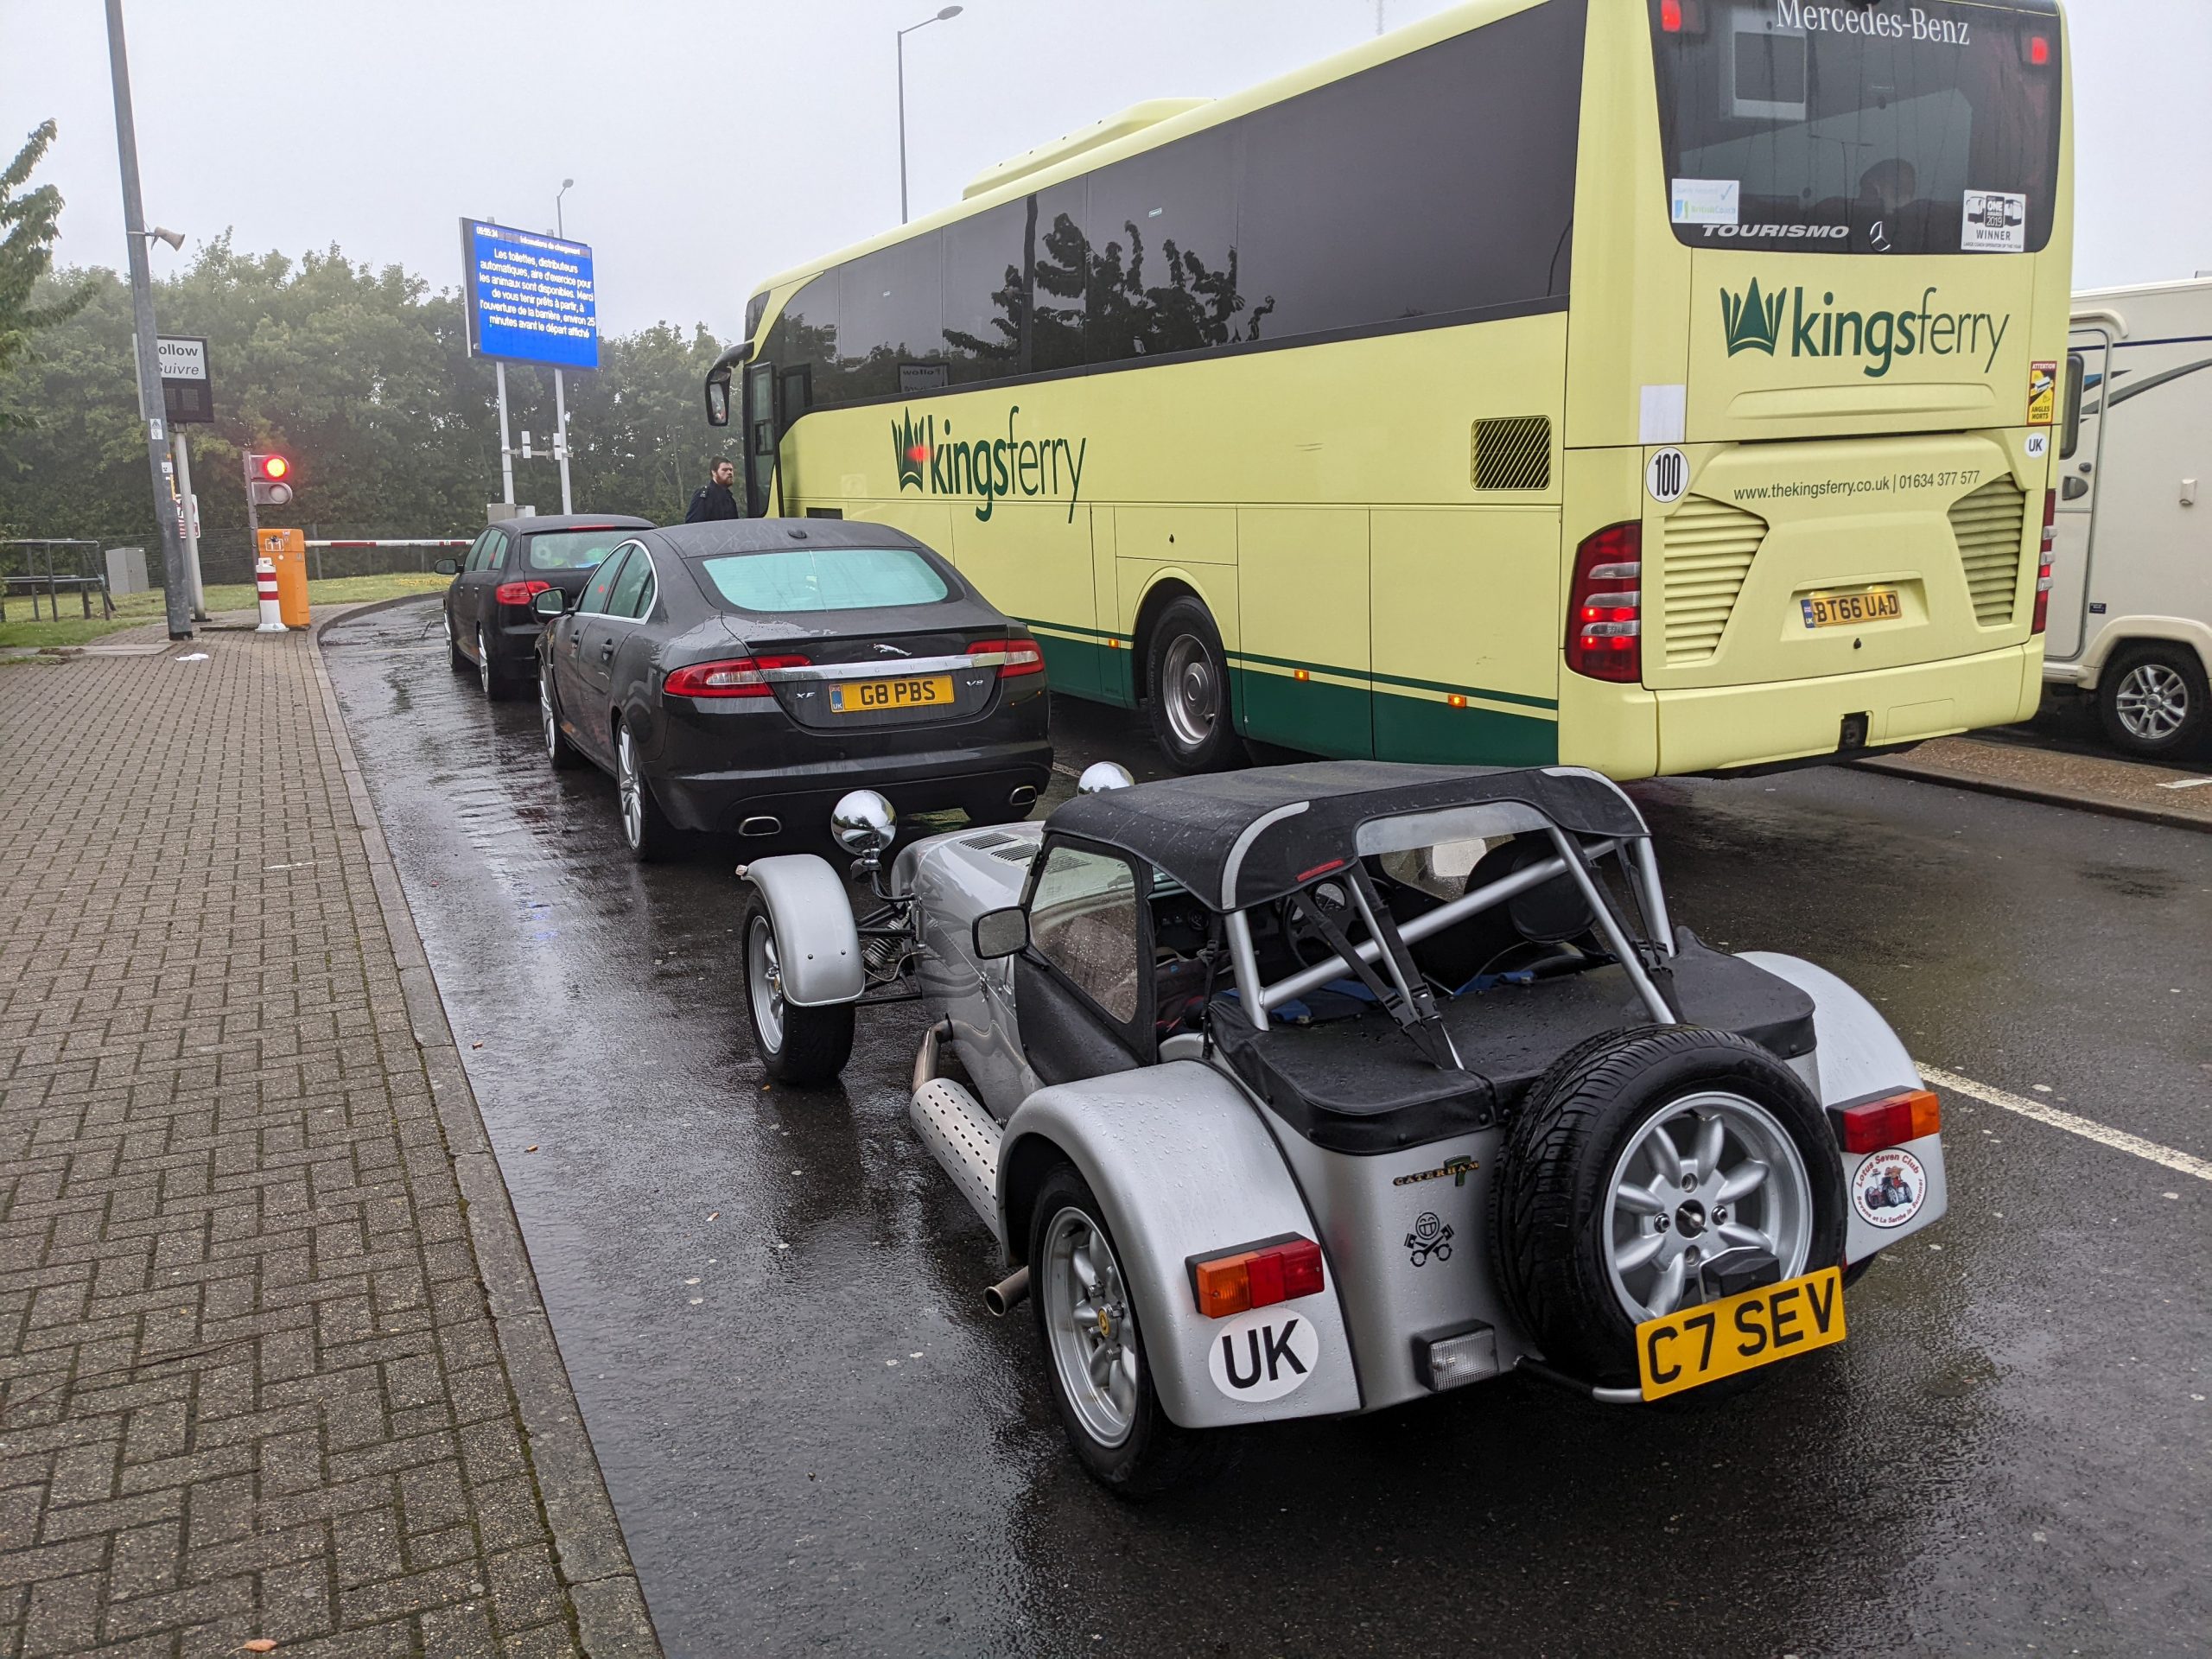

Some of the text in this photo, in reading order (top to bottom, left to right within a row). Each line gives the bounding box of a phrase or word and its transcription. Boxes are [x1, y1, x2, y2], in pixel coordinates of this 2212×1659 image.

[1777, 0, 1971, 45] Mercedes-Benz
[1702, 224, 1849, 238] TOURISMO
[1976, 229, 2011, 241] WINNER
[480, 260, 592, 289] automatiques, aire d'exercice pour
[494, 247, 579, 274] Les toilettes, distributeurs
[480, 272, 594, 302] les animaux sont disponibles. Merci
[492, 288, 501, 299] de
[502, 291, 519, 302] vous
[520, 292, 535, 304] tenir
[536, 296, 554, 308] prêts
[554, 298, 560, 308] à
[480, 299, 517, 314] l'ouverture
[518, 306, 527, 315] de
[527, 307, 535, 317] la
[563, 314, 587, 326] environ
[587, 316, 596, 327] 25
[489, 315, 590, 339] minutes avant le départ affiché
[1791, 286, 2010, 378] kingsferry
[158, 343, 199, 357] ollow
[2028, 438, 2044, 452] UK
[928, 405, 1087, 524] kingsferry
[1654, 453, 1681, 496] 100
[1733, 476, 1891, 500] www.thekingsferry.co.uk
[1899, 474, 1935, 490] 01634
[1937, 472, 1958, 486] 377
[1960, 470, 1980, 485] 577
[1814, 594, 1898, 623] BT66 UAD
[860, 680, 936, 706] G8 PBS
[1393, 1160, 1480, 1185] CATERHAM
[1856, 1154, 1920, 1188] Lotus Seven Club
[1647, 1276, 1835, 1386] C7 SEV
[1222, 1318, 1308, 1389] UK
